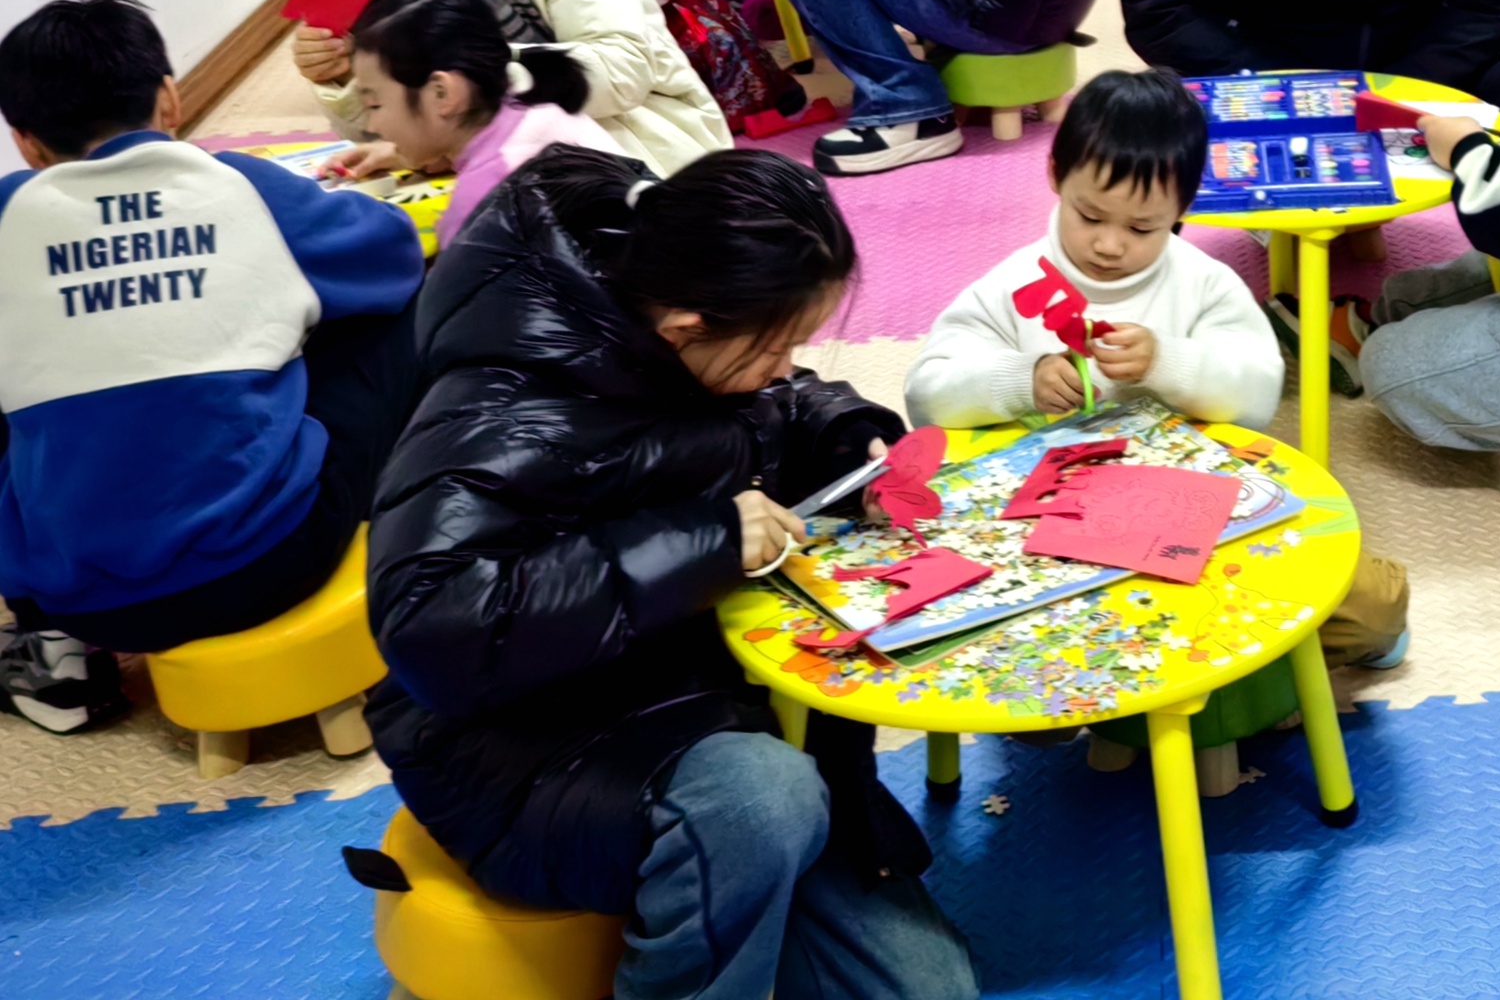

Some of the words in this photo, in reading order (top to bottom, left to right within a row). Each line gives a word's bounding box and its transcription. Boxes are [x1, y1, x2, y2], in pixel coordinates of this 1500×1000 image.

[95, 190, 163, 225] THE
[46, 224, 217, 276] NIGERIAN
[58, 268, 208, 318] TWENTY
